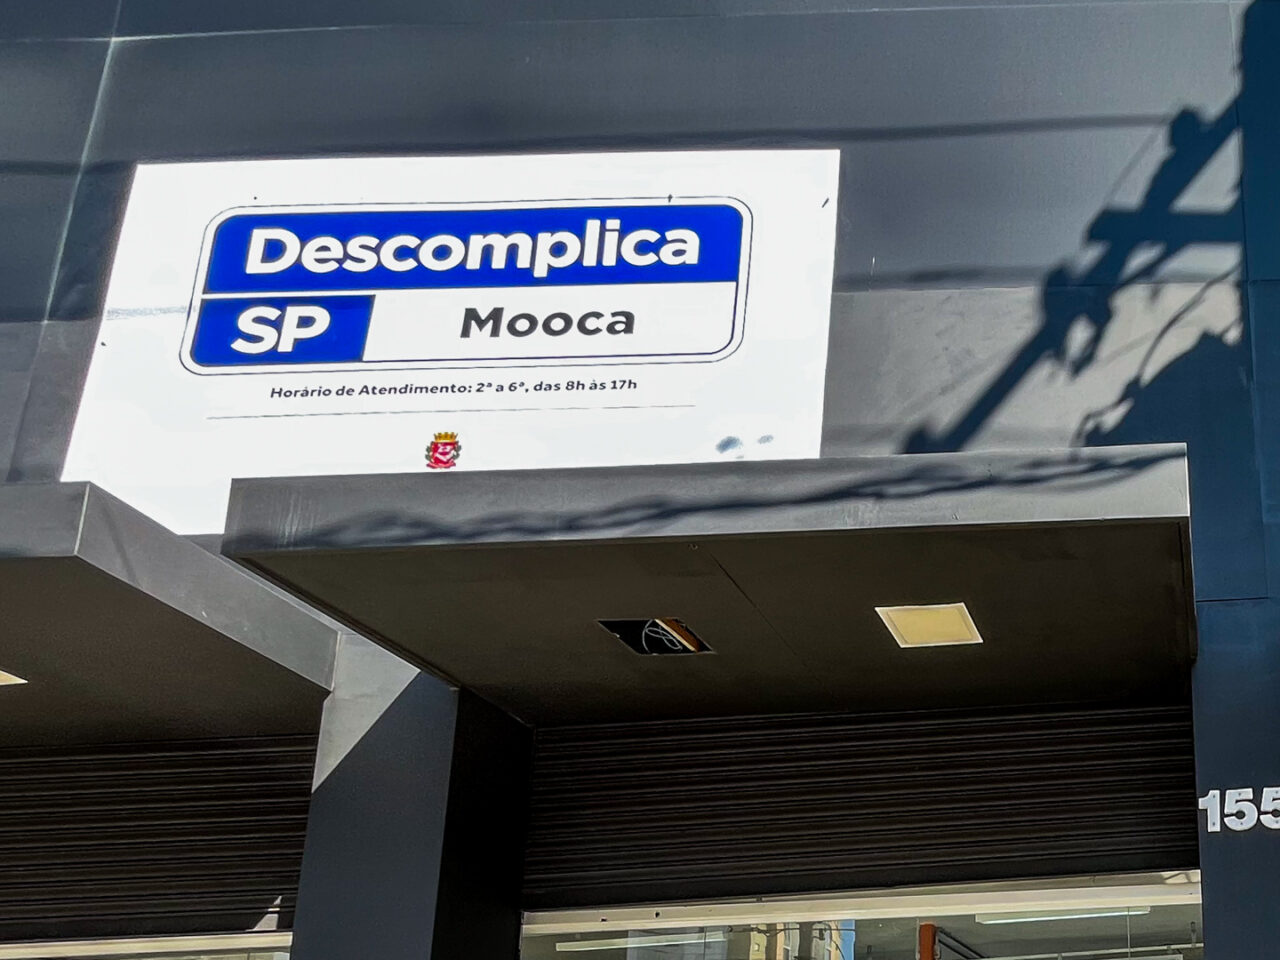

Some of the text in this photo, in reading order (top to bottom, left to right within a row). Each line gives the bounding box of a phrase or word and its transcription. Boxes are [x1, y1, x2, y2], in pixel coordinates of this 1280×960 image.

[245, 219, 700, 277] Descomplica
[230, 305, 331, 354] SP
[460, 307, 635, 338] Mooca
[335, 385, 355, 396] de
[358, 383, 472, 396] Atendimento:
[475, 382, 492, 393] 2ª
[495, 385, 504, 393] a
[533, 380, 561, 391] das
[565, 380, 585, 391] 8h
[610, 379, 637, 390] 17h
